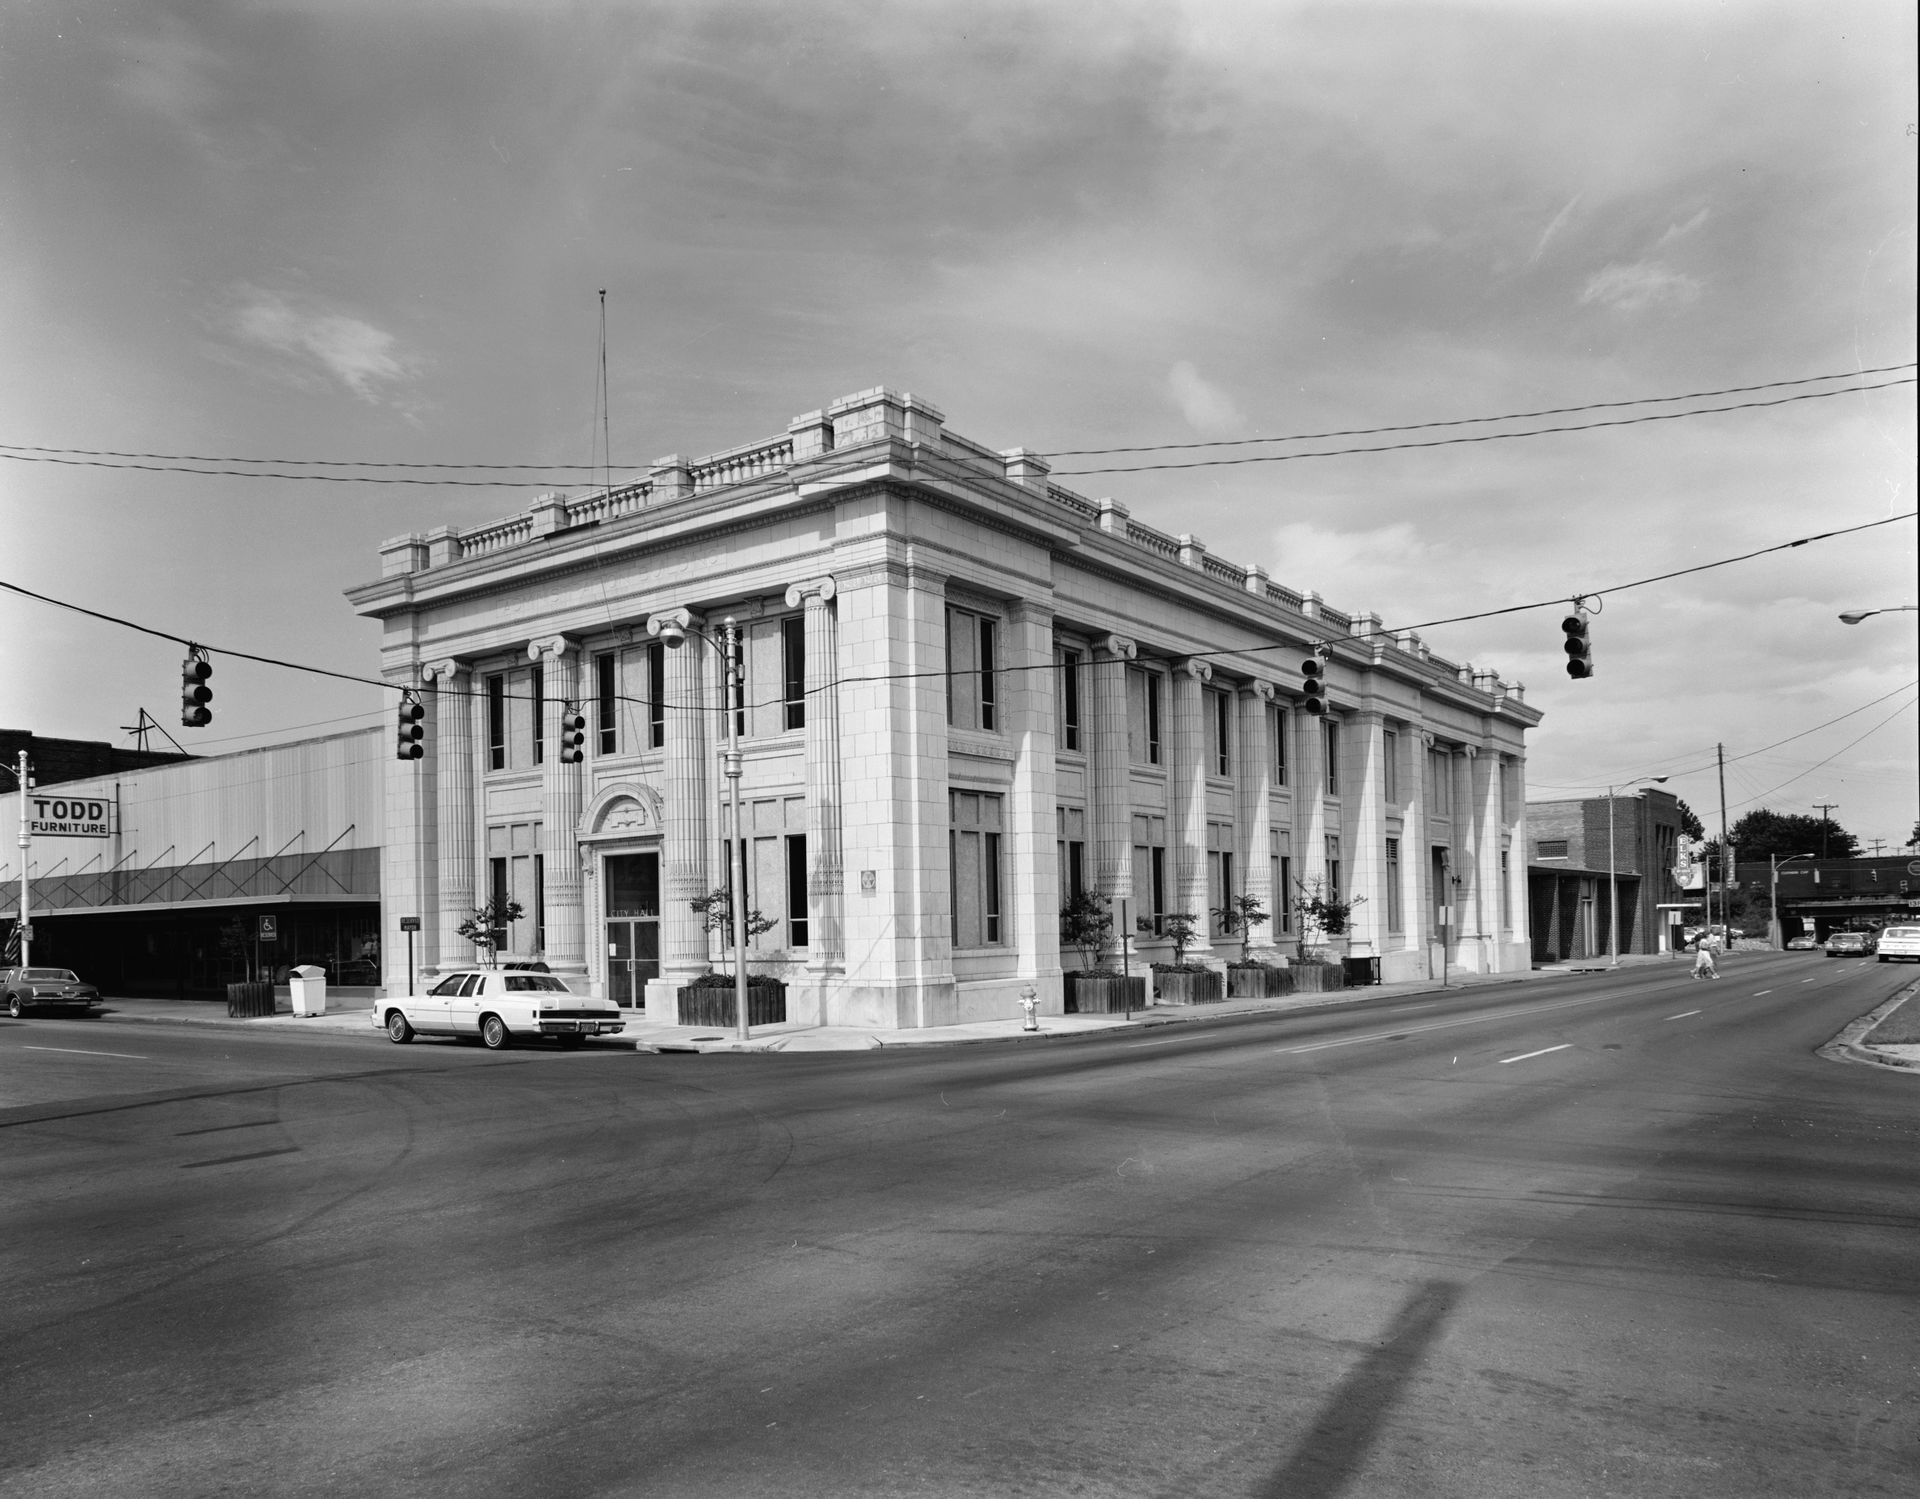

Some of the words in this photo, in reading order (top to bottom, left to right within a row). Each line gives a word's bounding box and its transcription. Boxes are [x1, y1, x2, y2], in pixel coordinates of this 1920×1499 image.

[33, 799, 103, 820] TODD
[31, 821, 106, 834] FURNITURE
[1679, 837, 1688, 867] ELKS
[610, 909, 629, 918] CITY
[634, 908, 654, 917] HALL
